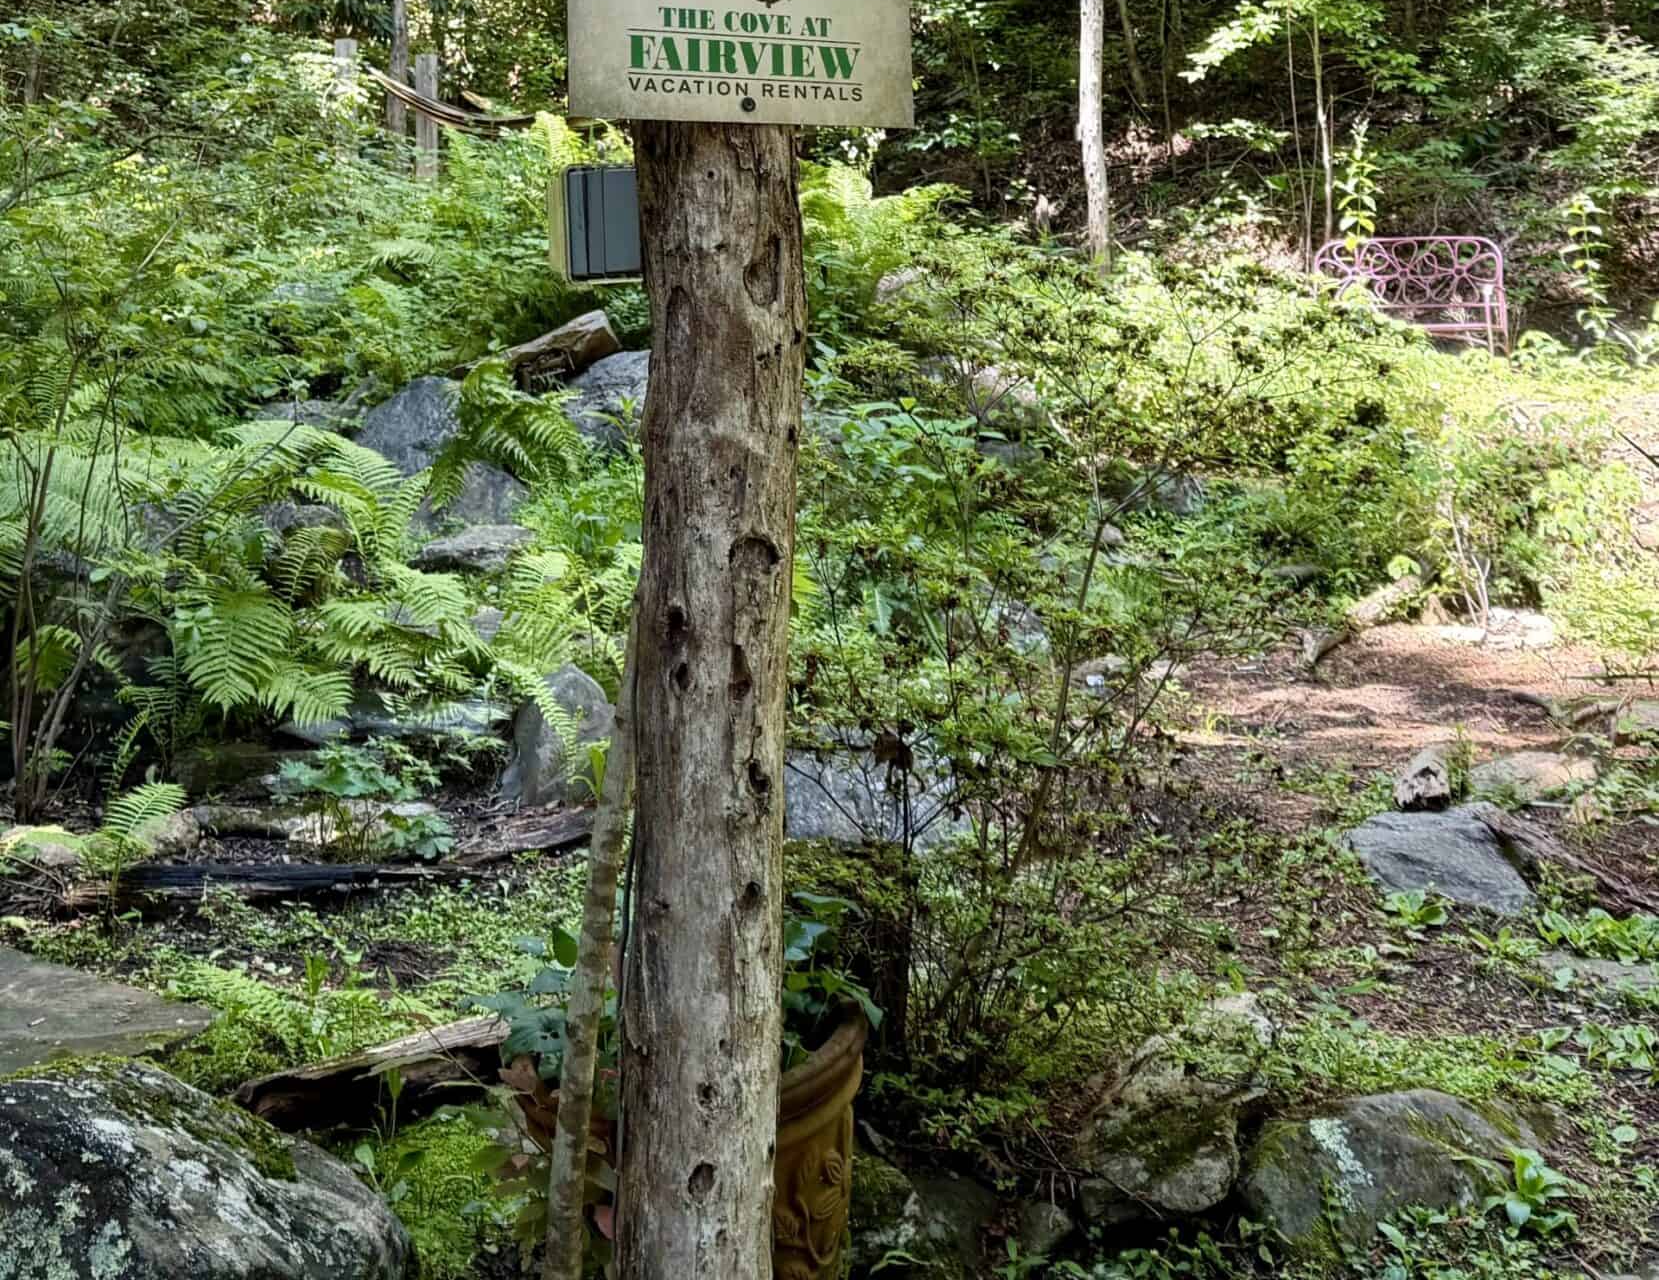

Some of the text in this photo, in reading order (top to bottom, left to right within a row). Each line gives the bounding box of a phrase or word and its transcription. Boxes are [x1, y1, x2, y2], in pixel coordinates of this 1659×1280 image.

[659, 6, 832, 38] THE COVE AT
[627, 34, 861, 80] FAIRVIEW
[629, 77, 863, 102] VACATION RENTALS
